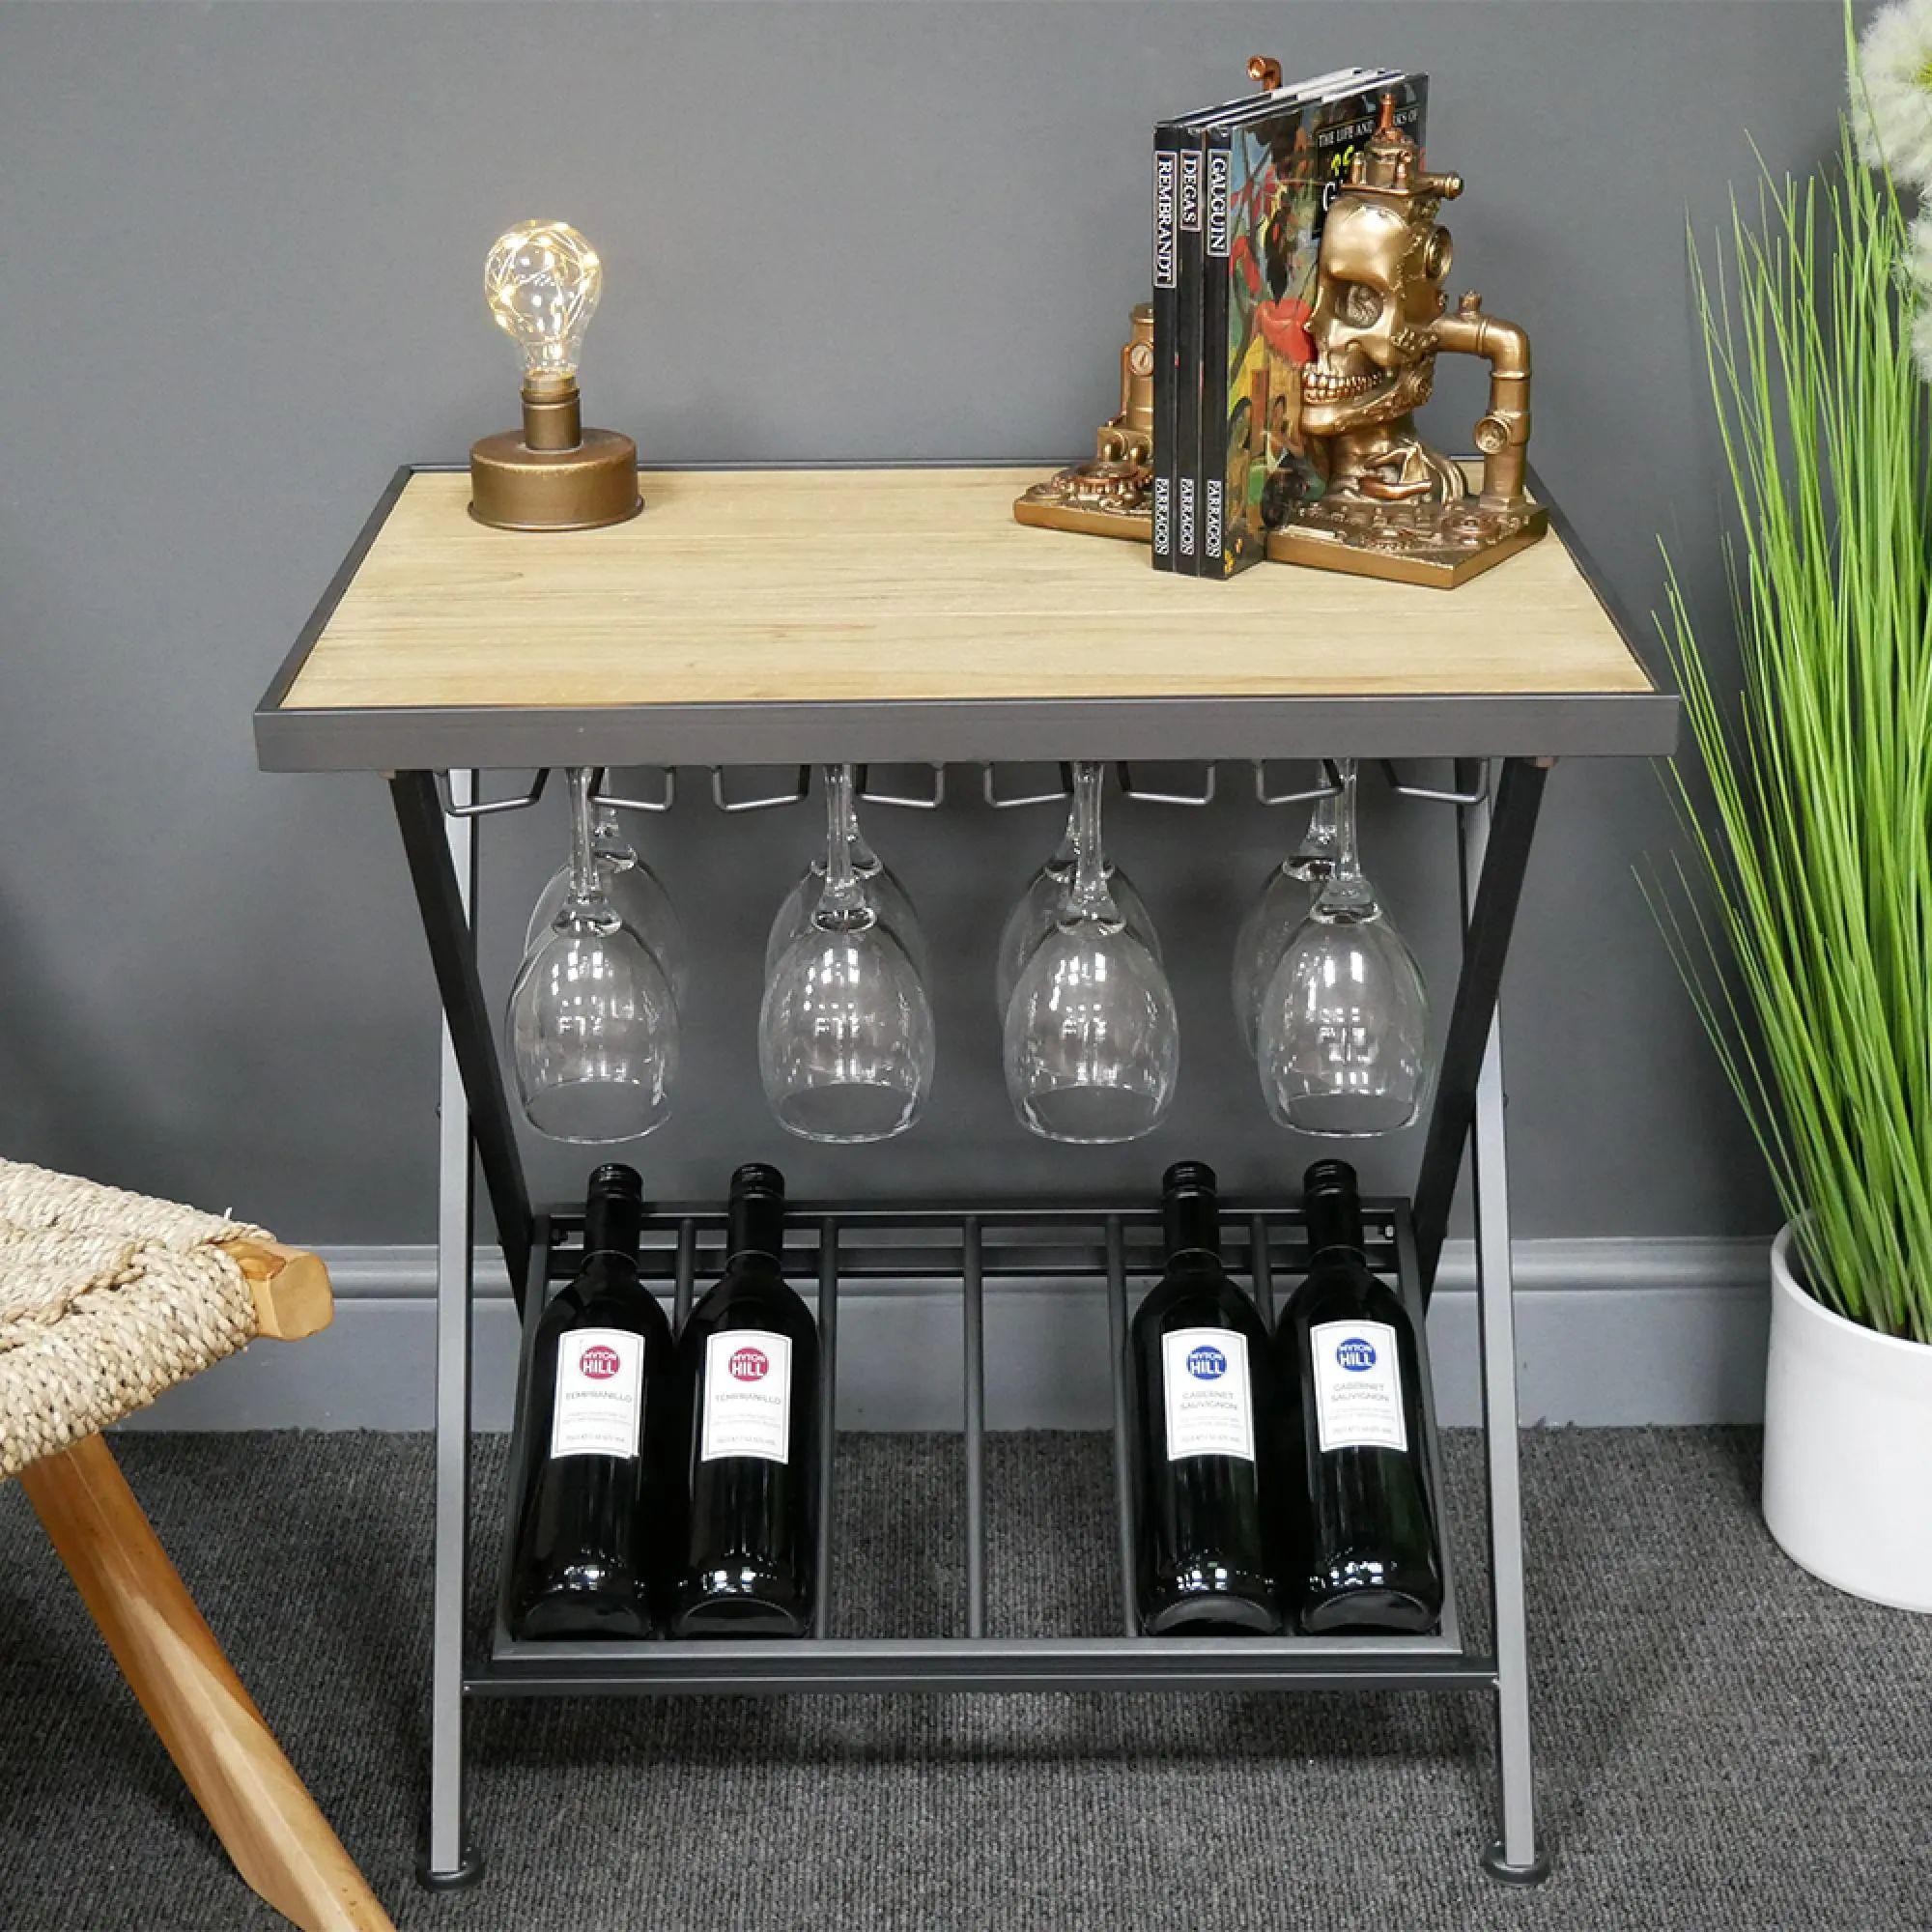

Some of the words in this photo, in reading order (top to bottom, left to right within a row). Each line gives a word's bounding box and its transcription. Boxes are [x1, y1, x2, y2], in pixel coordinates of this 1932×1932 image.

[1182, 158, 1197, 224] DEGAS
[1210, 157, 1226, 249] GAUGUIN
[1158, 160, 1172, 281] REMBRANDT
[582, 1359, 616, 1375] HILL
[1190, 1359, 1223, 1375] HILL
[1339, 1351, 1372, 1367] HILL
[731, 1361, 764, 1377] HILL
